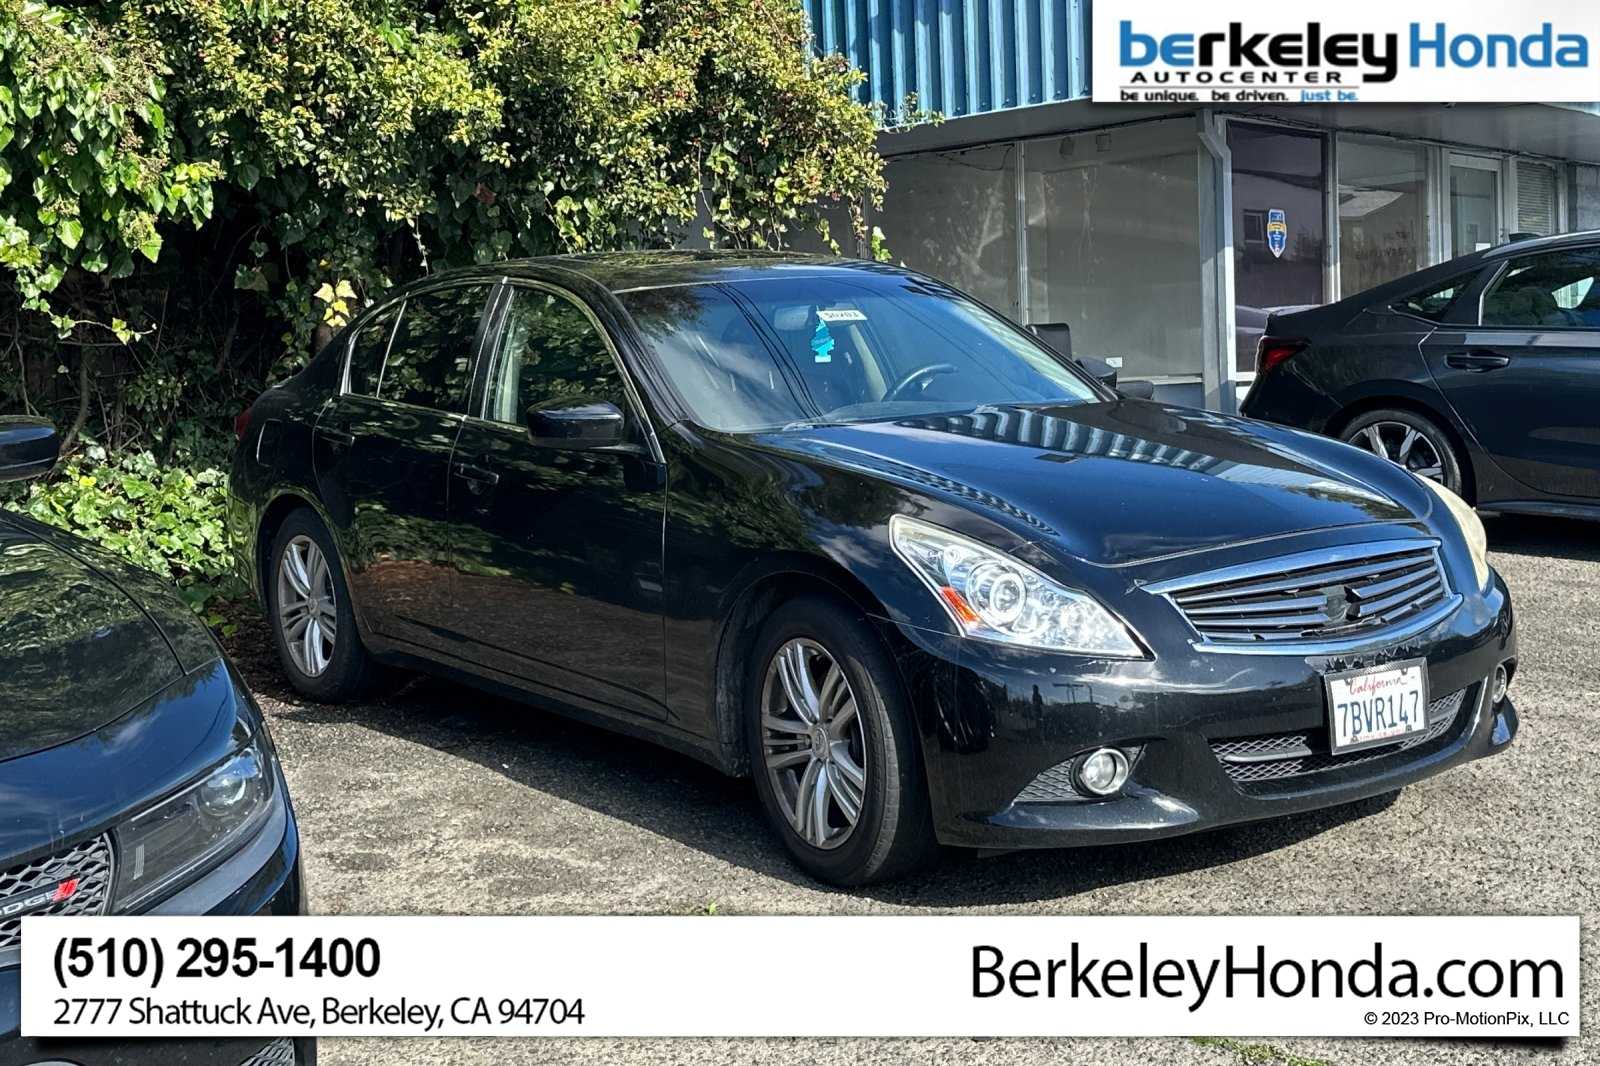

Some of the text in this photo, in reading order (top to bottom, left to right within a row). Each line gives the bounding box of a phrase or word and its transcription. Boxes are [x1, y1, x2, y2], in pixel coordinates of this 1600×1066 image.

[1350, 675, 1408, 696] California
[1336, 689, 1419, 738] 7BVR147
[0, 888, 57, 916] DGE
